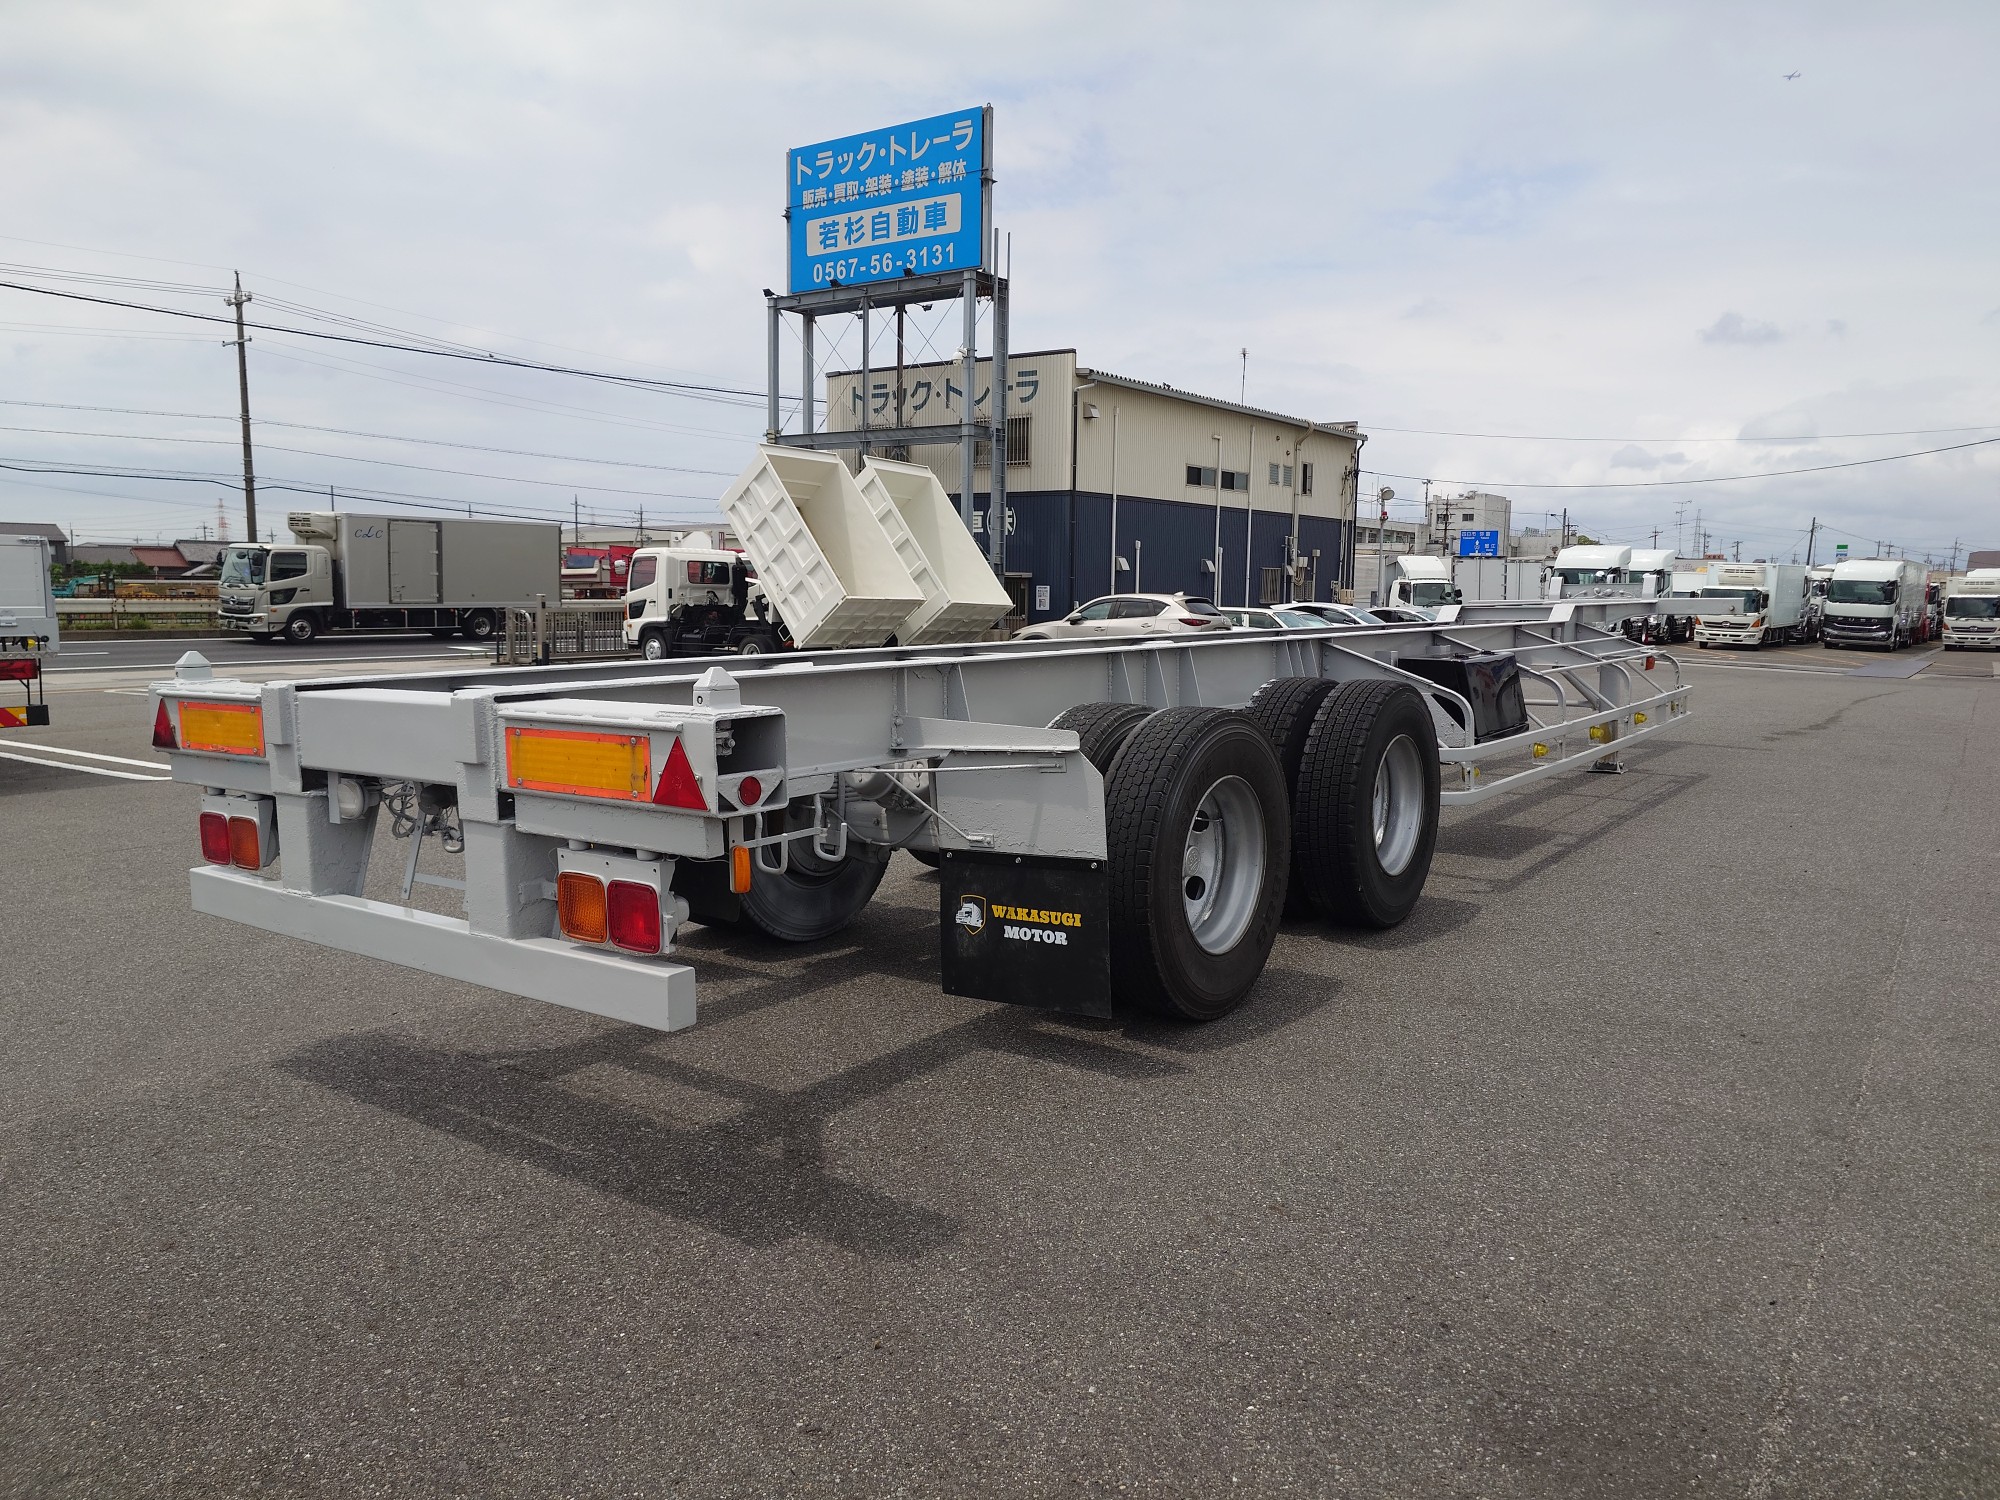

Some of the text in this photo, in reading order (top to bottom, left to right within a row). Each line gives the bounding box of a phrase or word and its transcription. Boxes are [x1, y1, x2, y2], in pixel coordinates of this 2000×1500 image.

[797, 120, 974, 186] トラック・トレーラ
[802, 158, 967, 210] 販売・買取・架装・塗装・解体
[819, 201, 947, 250] 若杉自動車
[813, 243, 955, 283] 0567-56-3131
[991, 904, 1082, 927] WAKASUGI
[1003, 925, 1068, 946] MOTOR
